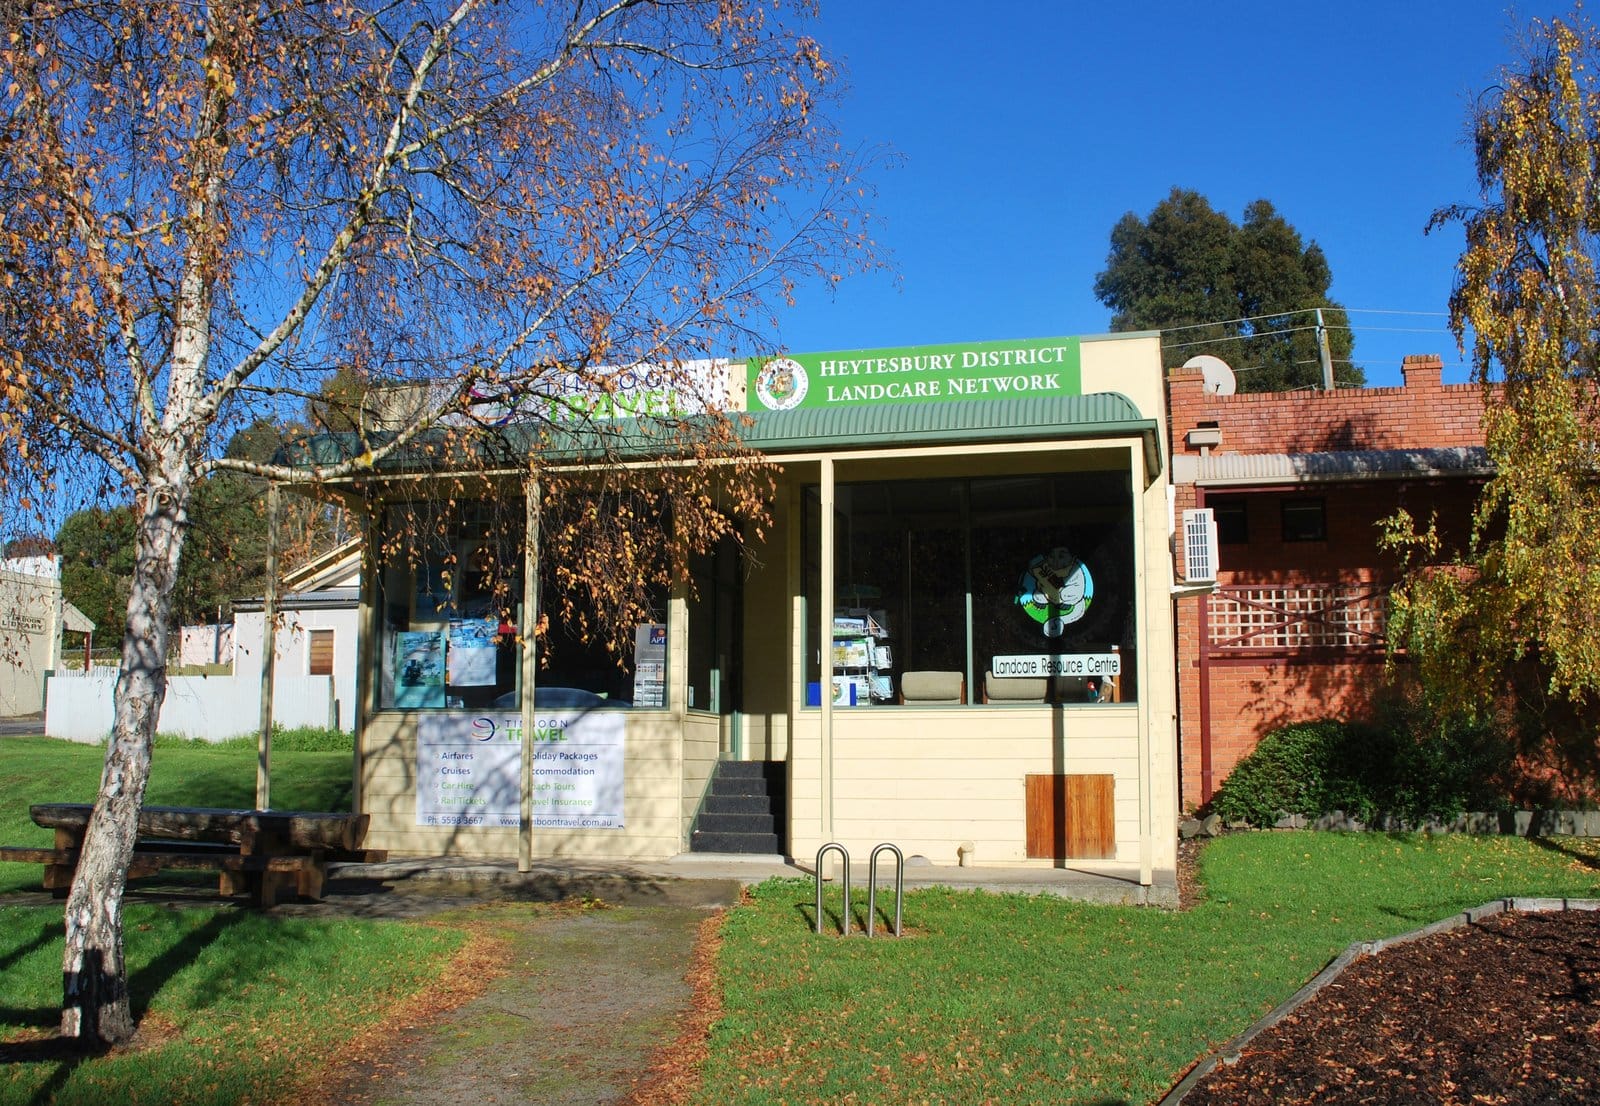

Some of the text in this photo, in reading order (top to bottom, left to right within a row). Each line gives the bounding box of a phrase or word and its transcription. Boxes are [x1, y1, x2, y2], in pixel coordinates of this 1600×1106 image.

[819, 346, 1067, 377] HEYTESBURY DISTRICT
[542, 369, 690, 396] TIMOON
[826, 373, 1061, 402] LANDCARE NETWORK
[995, 656, 1119, 674] Landcare Resource Centre
[505, 718, 568, 729] TIOON
[441, 751, 474, 760] Airfares
[532, 751, 598, 762] oliday Packages
[441, 766, 471, 775] Cruises
[532, 767, 595, 776] ccommodation
[441, 782, 475, 790] Car Hire
[532, 781, 576, 791] oach Tours
[441, 796, 487, 806] Rail Tickets
[531, 797, 593, 807] avel Insurance
